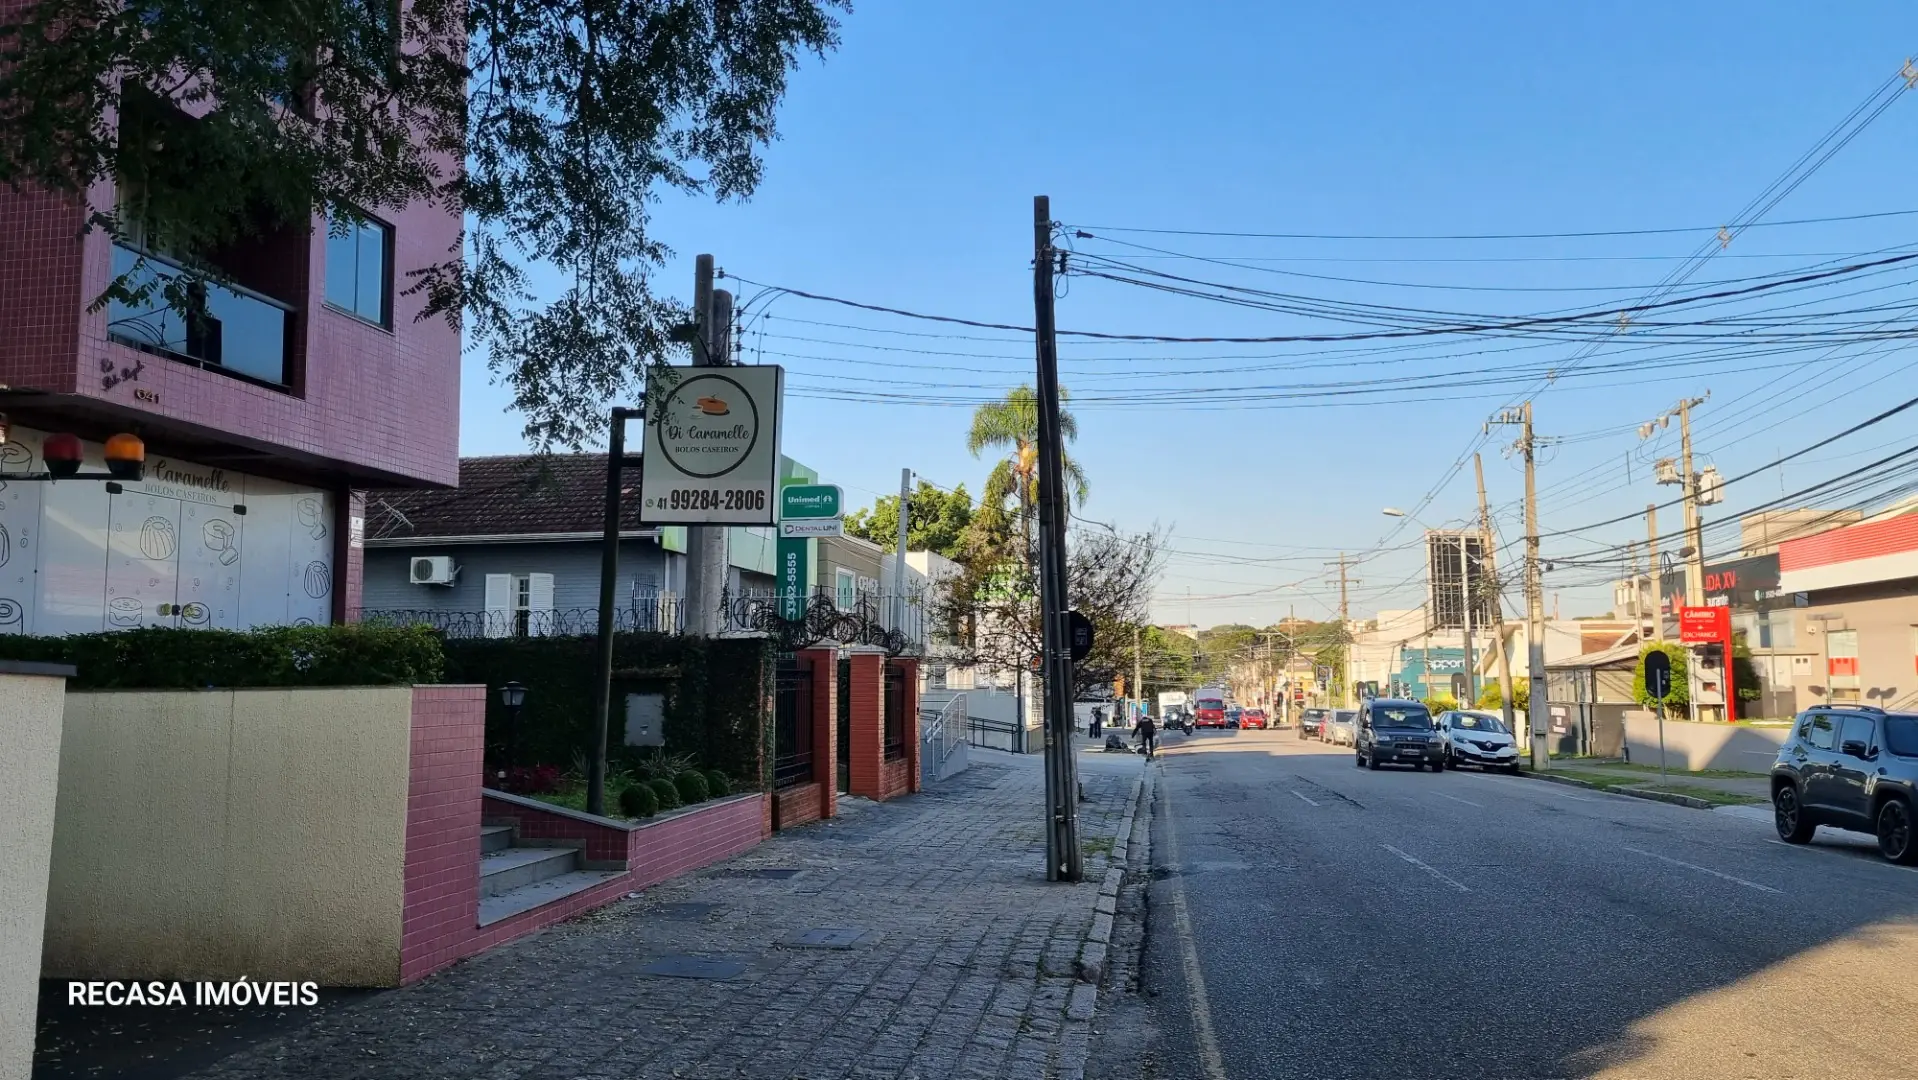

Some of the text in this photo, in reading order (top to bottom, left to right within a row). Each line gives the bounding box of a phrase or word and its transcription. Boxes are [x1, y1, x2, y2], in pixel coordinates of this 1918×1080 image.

[665, 424, 750, 440] Di Caramelle
[153, 459, 230, 493] Caramelle
[144, 483, 217, 503] BOLOS CASEIROS
[657, 489, 765, 511] 41 99284-2806
[787, 495, 821, 504] Unimed
[1683, 631, 1718, 639] EXCHANGE
